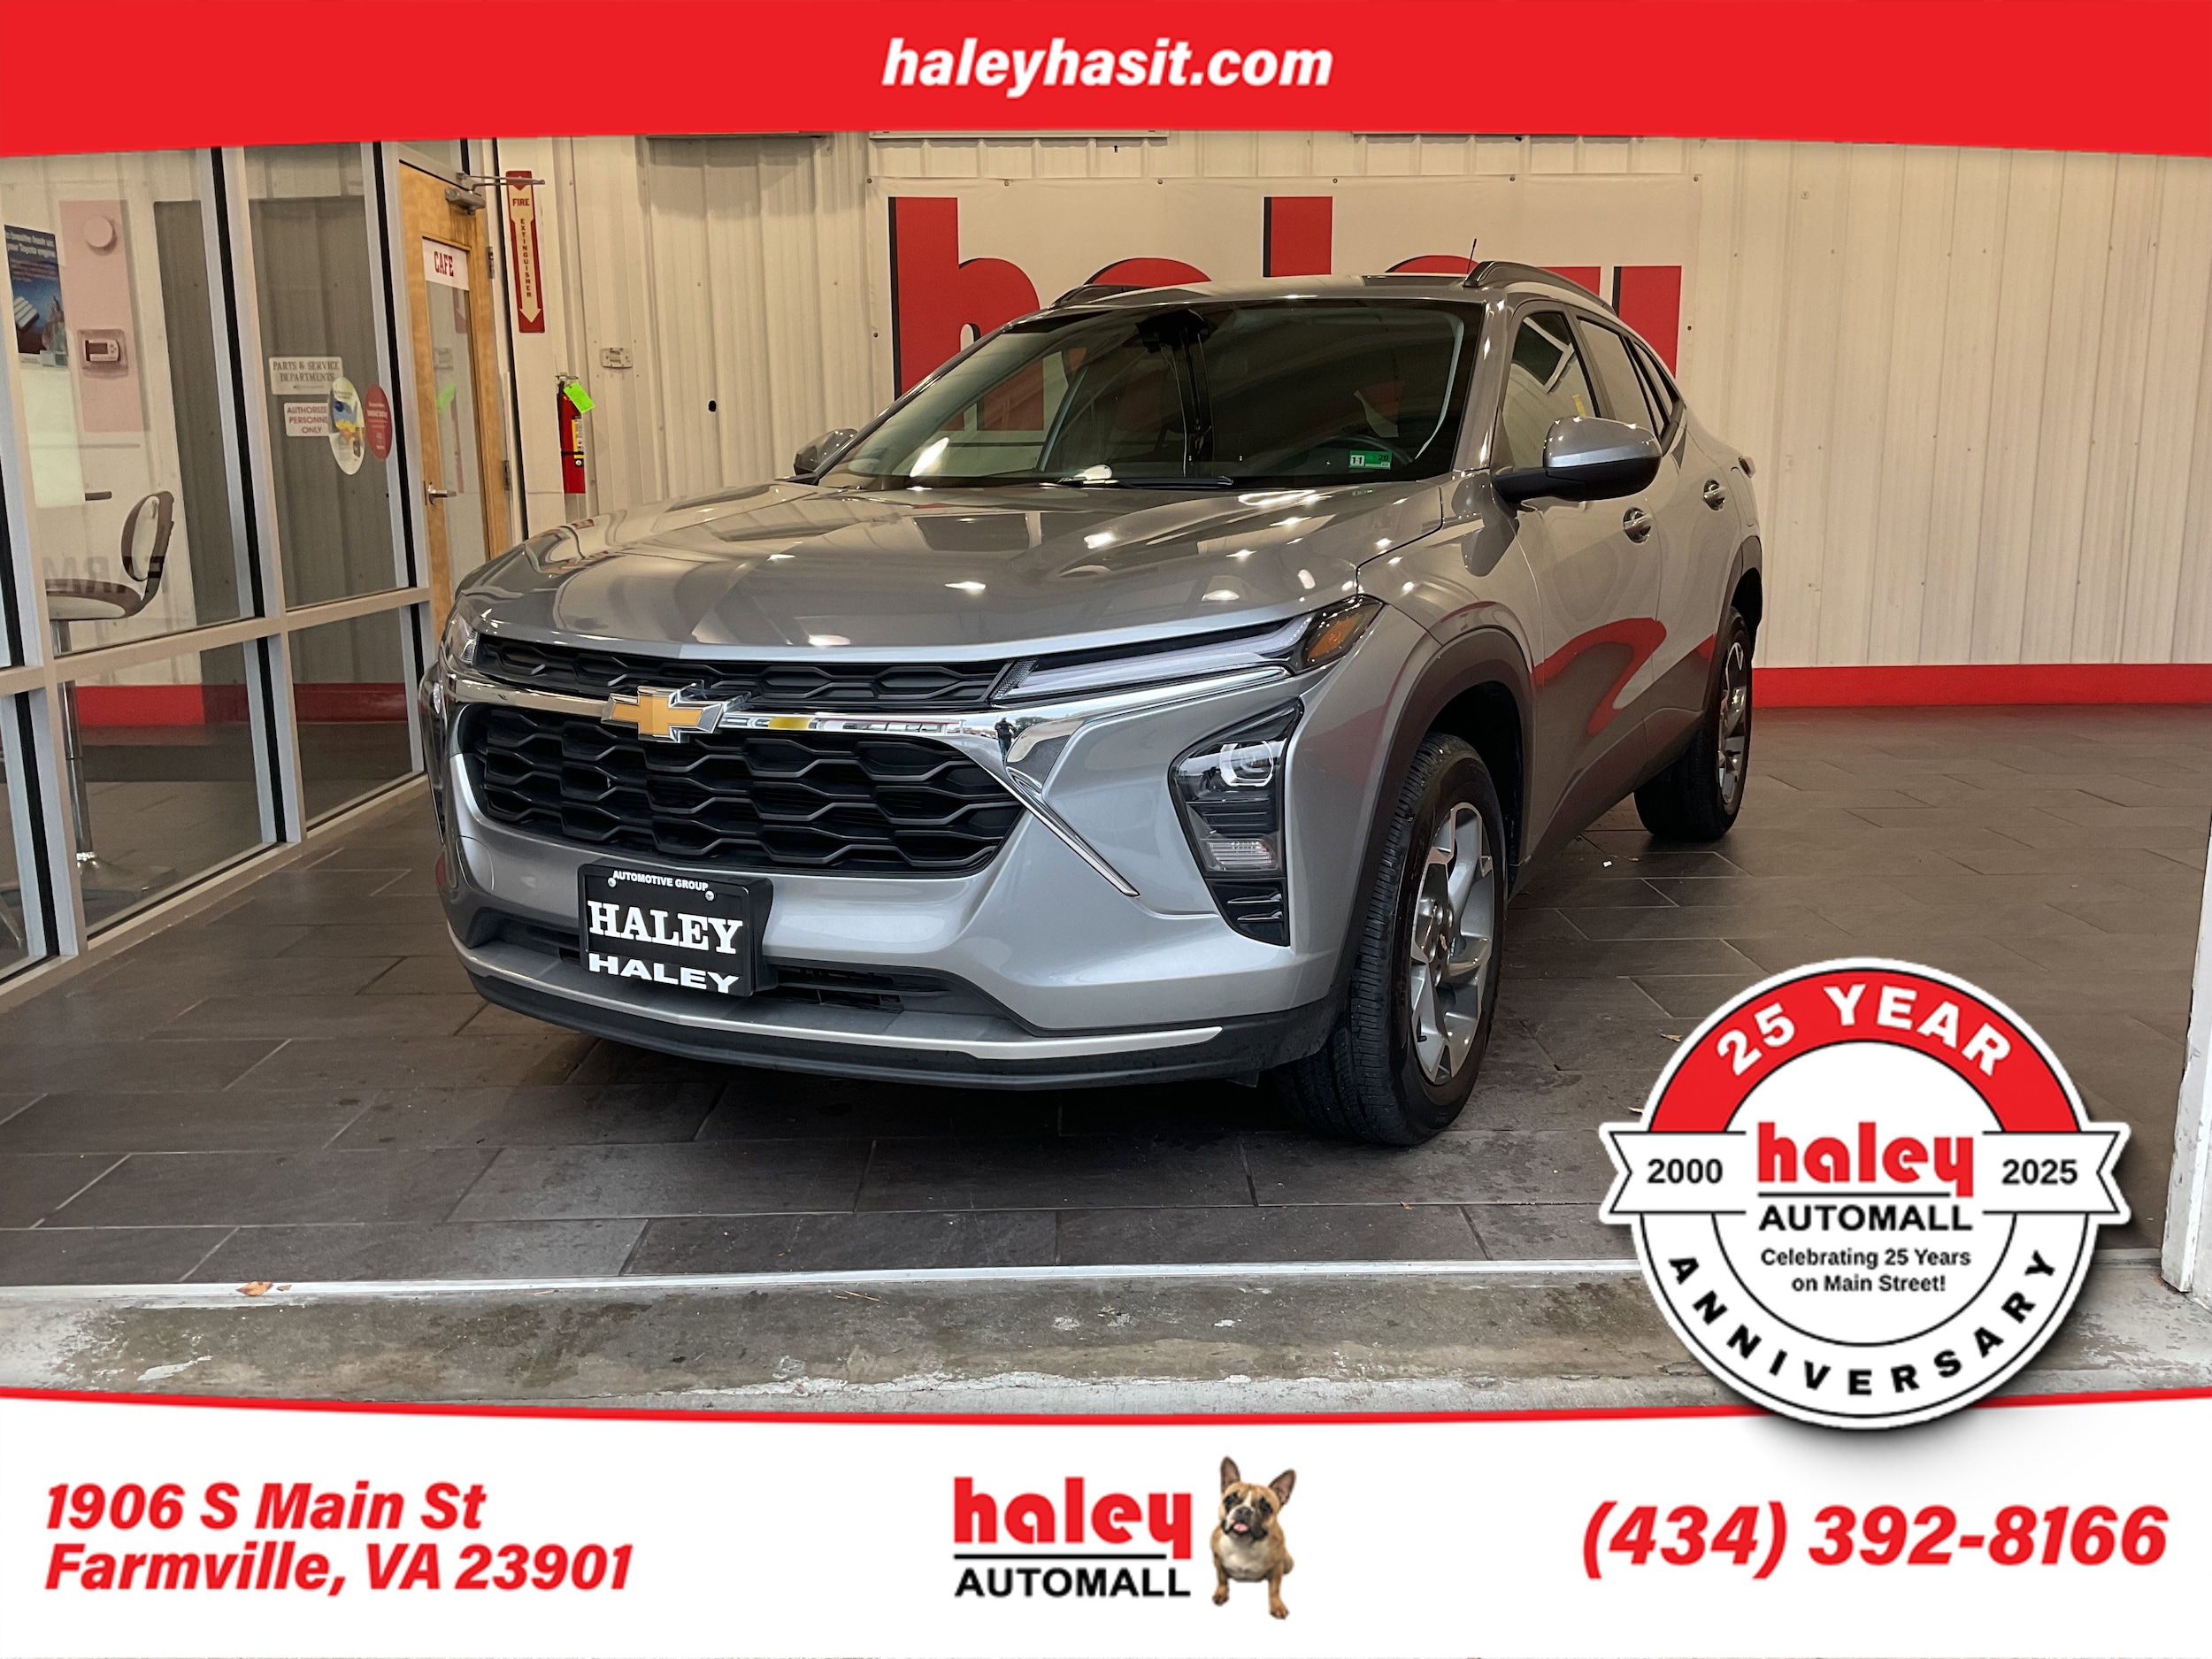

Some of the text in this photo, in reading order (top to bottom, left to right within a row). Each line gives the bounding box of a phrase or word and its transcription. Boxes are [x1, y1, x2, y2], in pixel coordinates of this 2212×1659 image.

[512, 197, 530, 207] FIRE
[434, 250, 455, 278] CAFE
[519, 218, 532, 298] EXTINGUISHER
[273, 361, 340, 371] PARTS & SERVICE
[280, 373, 334, 381] DEPARTMENTS
[612, 870, 709, 892] AUTOMOTIVE GROUP
[587, 900, 743, 955] HALEY
[588, 953, 740, 994] HALEY
